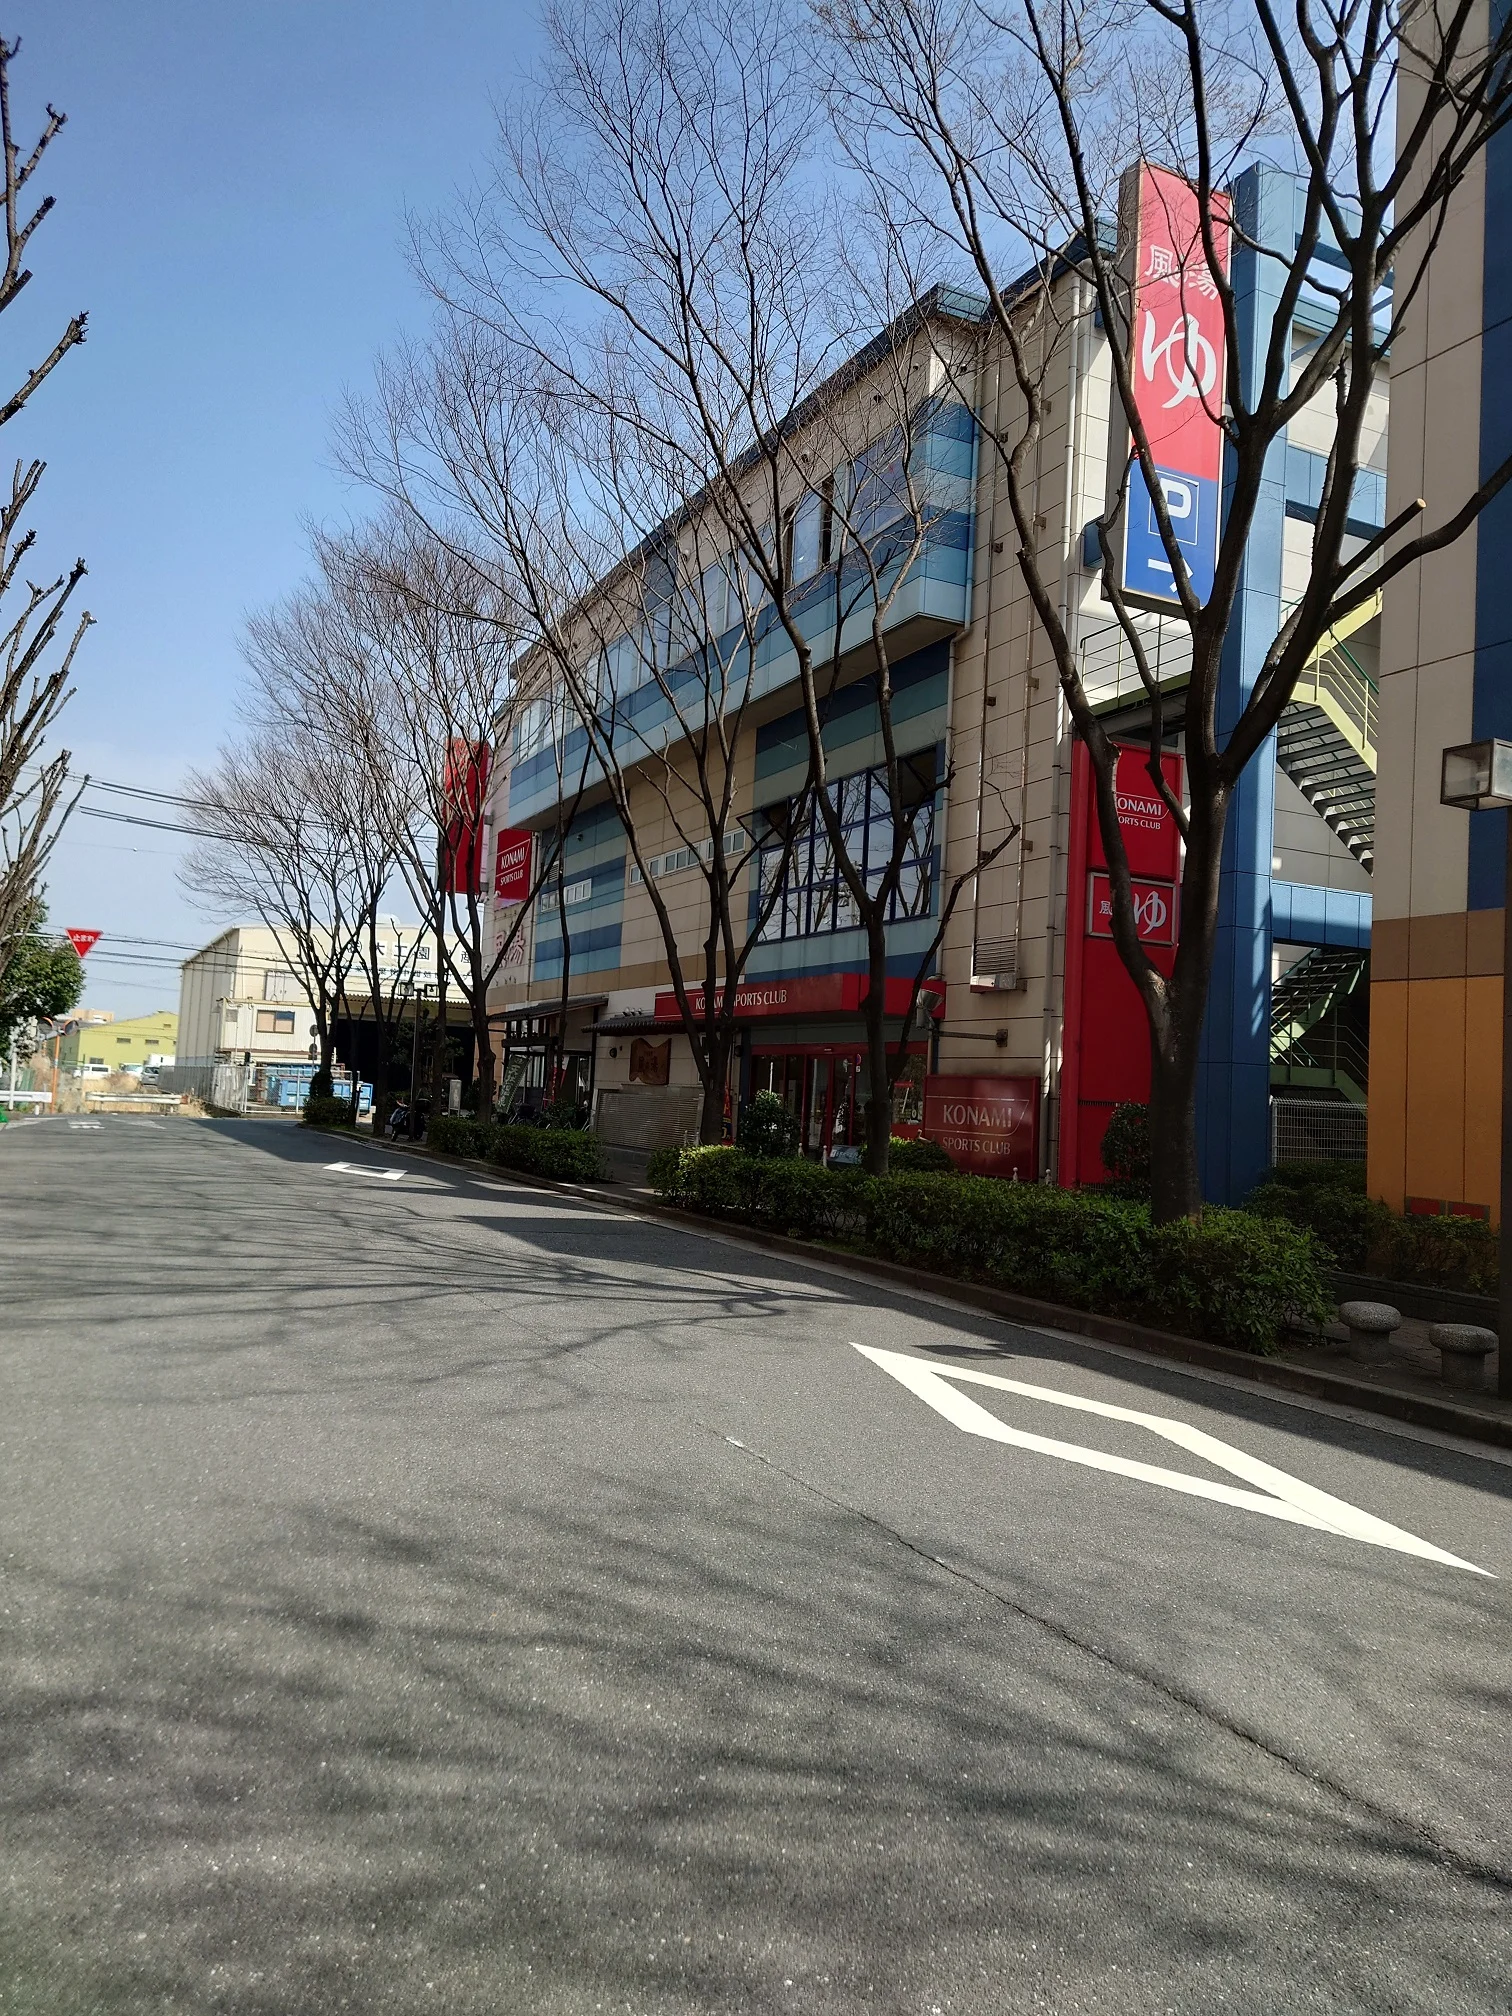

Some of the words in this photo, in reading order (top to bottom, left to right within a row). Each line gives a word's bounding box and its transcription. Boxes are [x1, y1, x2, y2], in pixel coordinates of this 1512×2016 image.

[1141, 309, 1217, 410] ゆ
[1158, 478, 1192, 520] P
[1116, 797, 1162, 816] ONAMI
[1118, 815, 1139, 826] ORTS
[1140, 819, 1161, 830] CLUB
[500, 847, 525, 869] KONAMI
[1133, 890, 1167, 935] ゆ
[733, 991, 762, 1007] PORTS
[763, 989, 787, 1005] CLUB
[943, 1104, 1012, 1128] KONAMI
[942, 1136, 981, 1153] SPORTS
[982, 1140, 1011, 1155] CLUB
